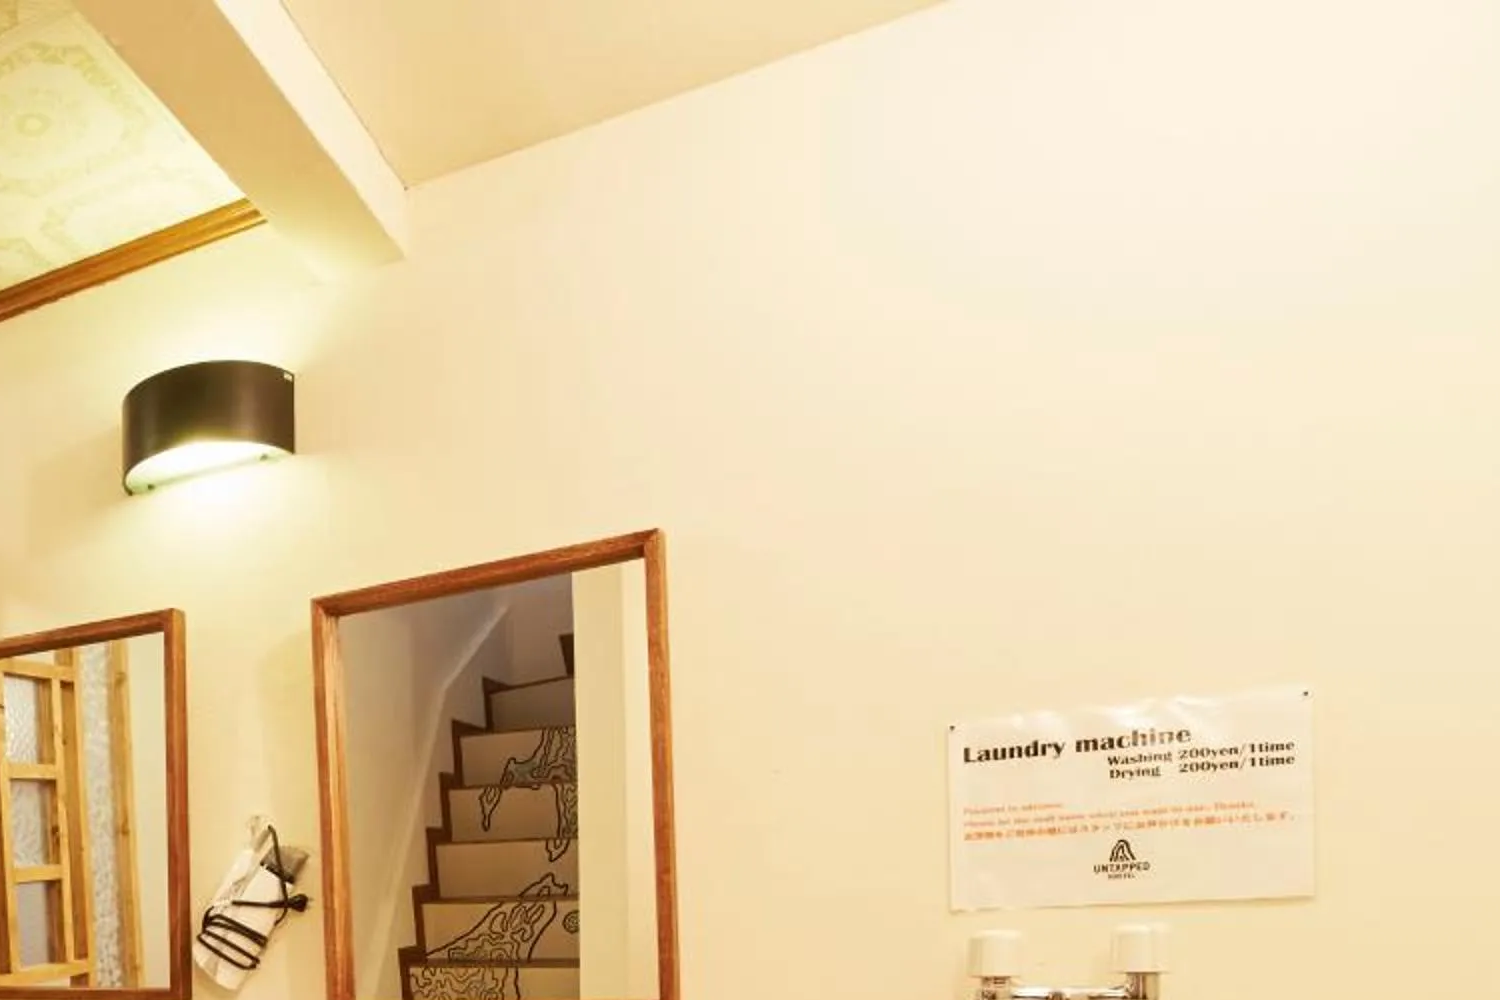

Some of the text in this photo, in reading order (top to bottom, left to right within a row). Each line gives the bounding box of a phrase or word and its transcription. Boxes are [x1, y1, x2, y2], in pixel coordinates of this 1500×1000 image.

[963, 728, 1192, 763] Laundry machine
[1107, 751, 1173, 767] Washing
[1109, 766, 1161, 781] Drying
